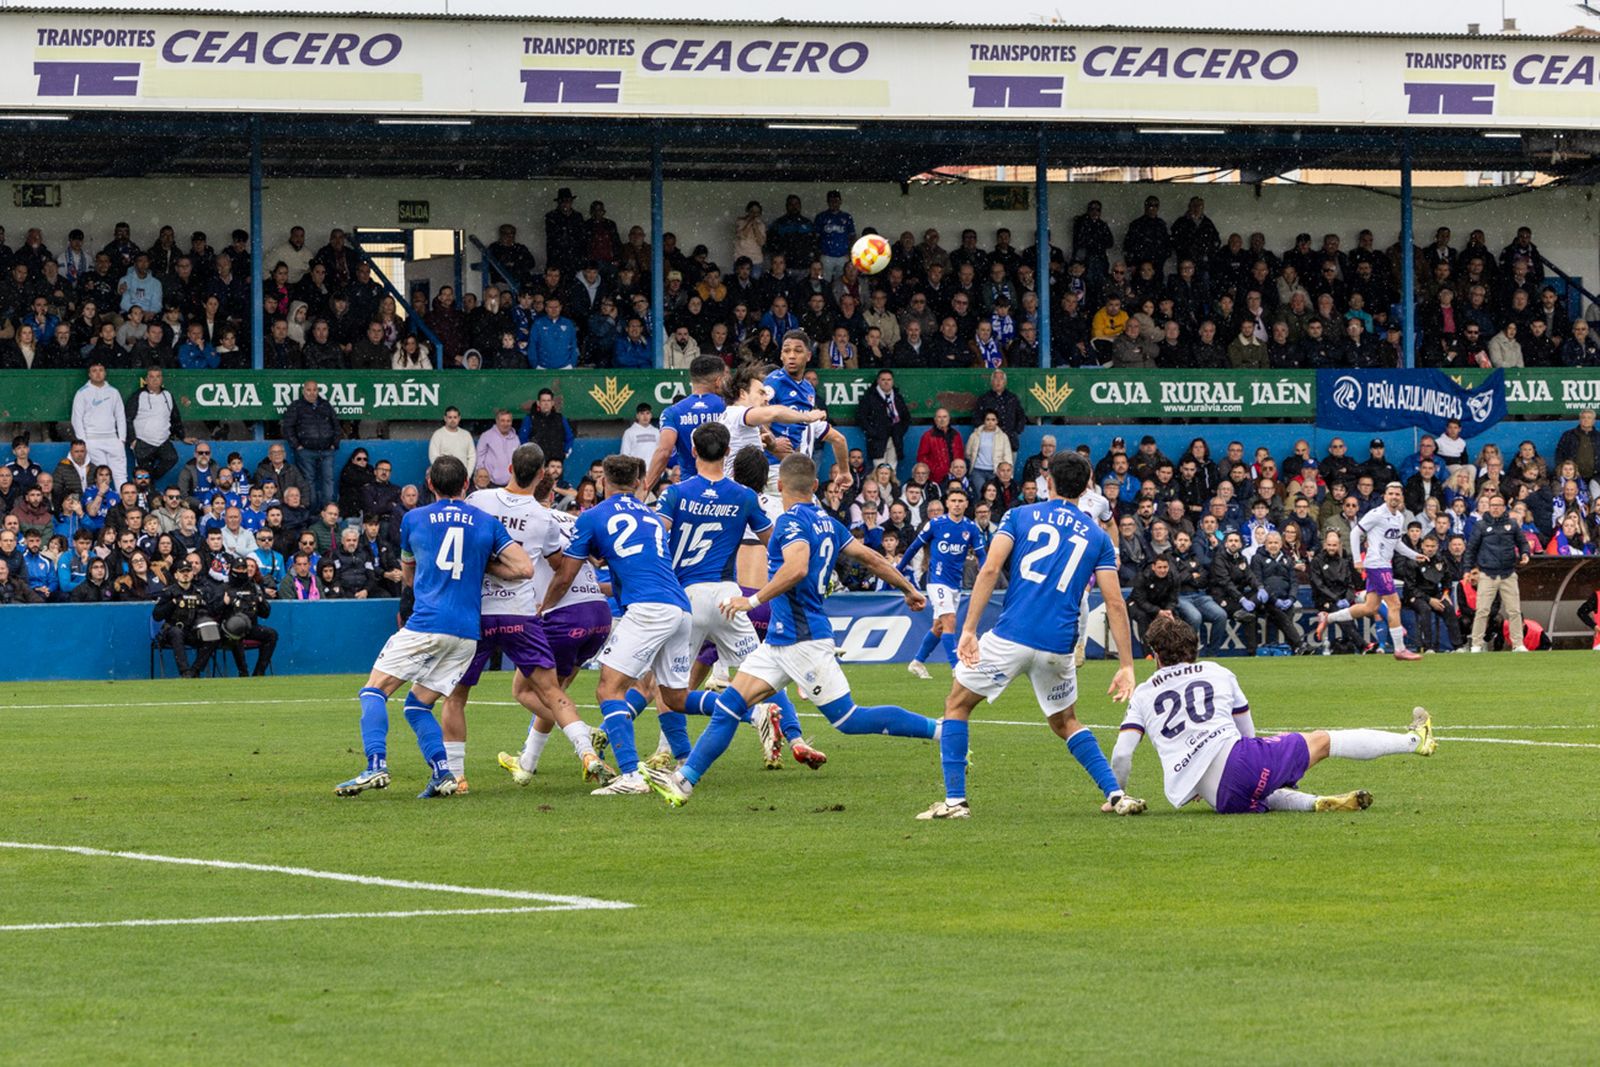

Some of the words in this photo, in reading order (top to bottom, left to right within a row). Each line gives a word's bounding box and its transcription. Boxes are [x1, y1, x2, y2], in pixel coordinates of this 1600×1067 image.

[37, 28, 155, 48] TRANSPORTES
[161, 29, 403, 66] CEACERO
[522, 37, 635, 57] TRANSPORTES
[641, 38, 869, 74] CEACERO
[970, 44, 1076, 63] TRANSPORTES
[1082, 45, 1299, 80] CEACERO
[1405, 52, 1507, 71] TRANSPORTES
[1512, 54, 1600, 86] CEA
[400, 204, 429, 218] SALIDA
[195, 383, 262, 407] CAJA
[373, 379, 440, 407] JAÉN
[654, 381, 694, 404] CA
[823, 378, 873, 406] JAÉ
[1090, 382, 1151, 405] CAJA
[1160, 382, 1244, 404] RURAL
[1251, 378, 1311, 406] JAÉN
[1367, 380, 1396, 409] PEÑA
[1504, 380, 1554, 403] AJA
[679, 411, 699, 426] JOÃO
[701, 412, 722, 424] PAU
[1163, 403, 1242, 412] www.ruralvia.com
[429, 512, 474, 526] RAFAEL
[688, 500, 739, 518] VELÁZQUEZ
[493, 515, 527, 532] ENE
[607, 512, 665, 559] 27
[1033, 510, 1044, 522] V.
[1047, 511, 1089, 537] LÓPEZ
[435, 526, 464, 580] 4
[672, 522, 723, 571] 15
[1020, 523, 1089, 593] 21
[817, 536, 834, 595] 2
[937, 588, 945, 599] 8
[484, 624, 524, 637] HYNDAI
[1153, 680, 1215, 739] 20
